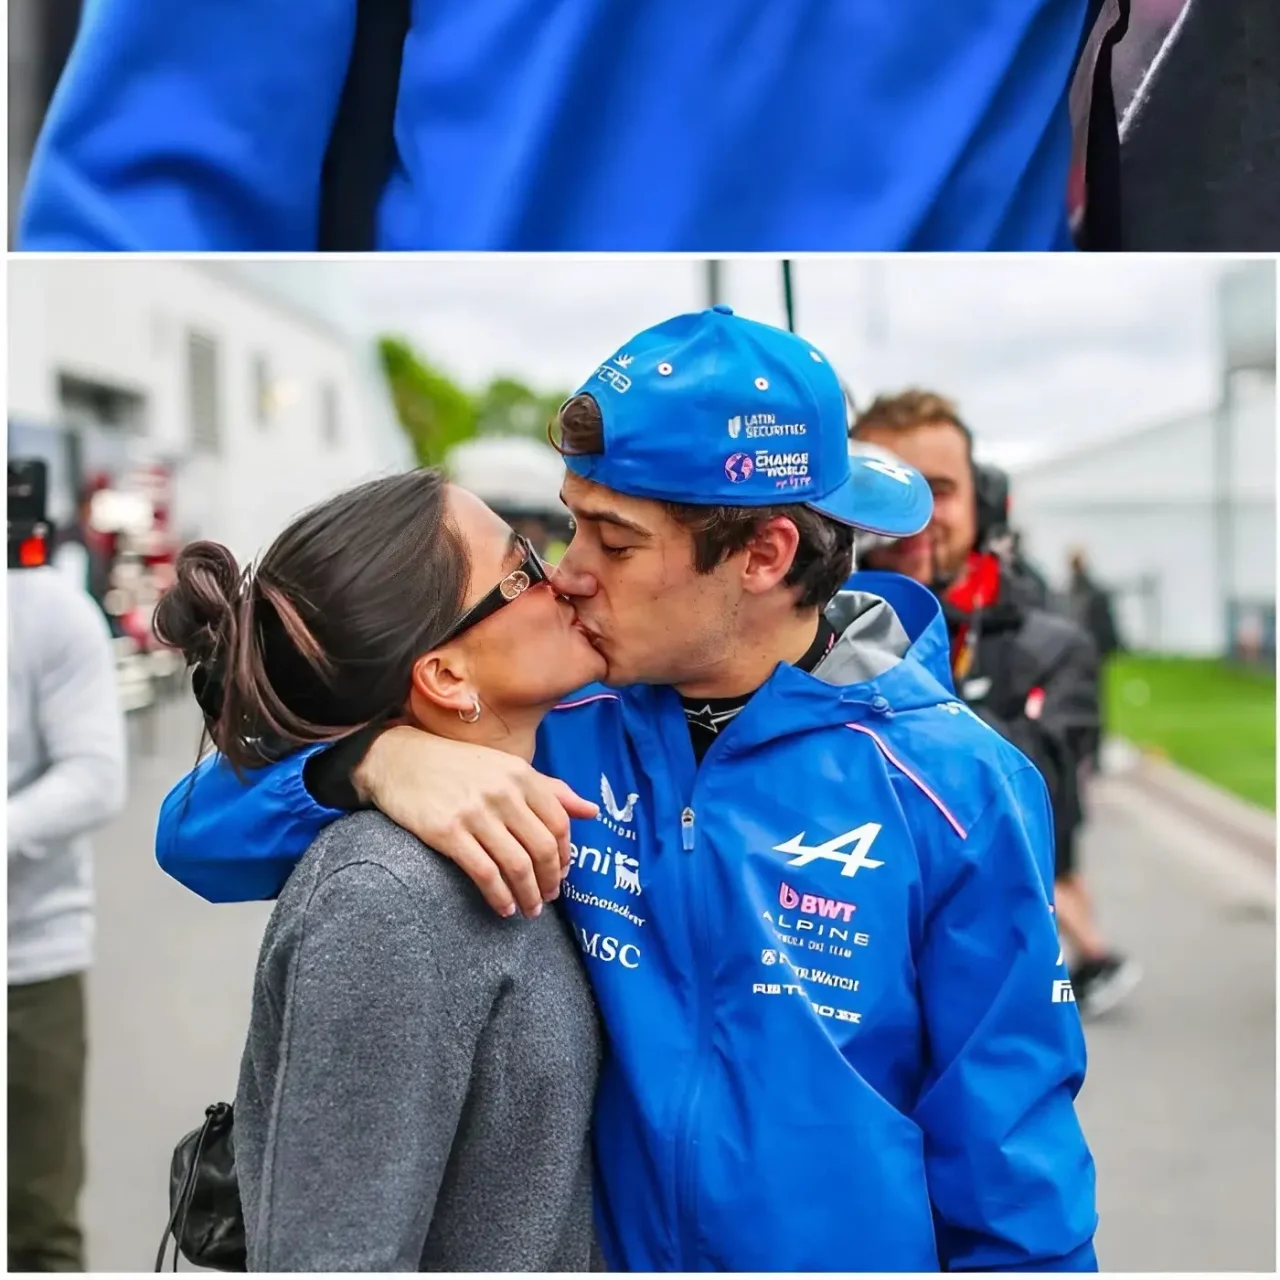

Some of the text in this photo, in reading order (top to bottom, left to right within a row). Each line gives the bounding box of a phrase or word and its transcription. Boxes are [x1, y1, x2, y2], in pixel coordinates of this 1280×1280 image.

[801, 894, 857, 922] BWT
[762, 910, 870, 947] ALPINE
[582, 928, 641, 969] MSC
